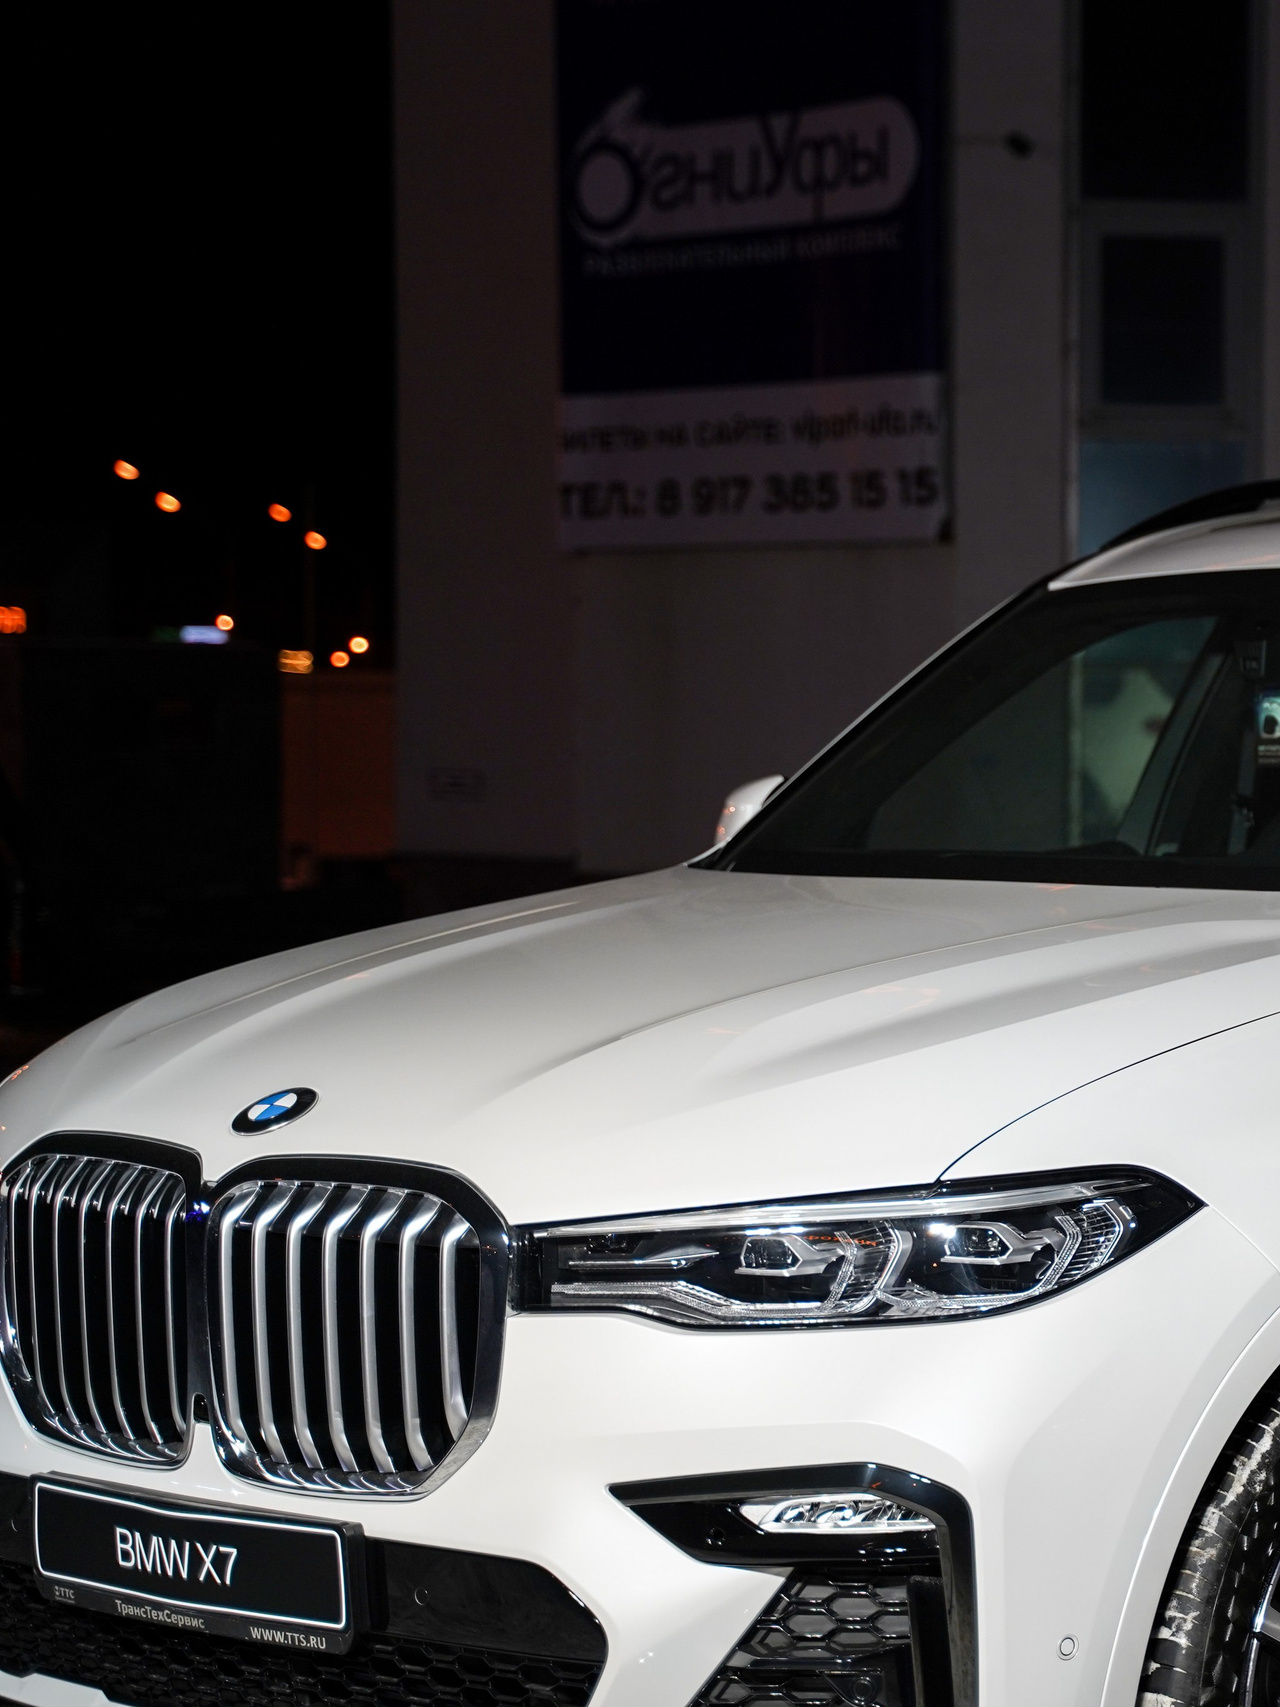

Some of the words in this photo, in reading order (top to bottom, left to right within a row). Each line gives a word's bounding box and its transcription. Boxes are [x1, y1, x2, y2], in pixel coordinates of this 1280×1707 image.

[655, 476, 682, 518] 8
[690, 474, 753, 516] 917
[848, 467, 888, 511] 15
[897, 466, 939, 508] 15
[114, 1526, 191, 1580] BMW
[195, 1541, 238, 1587] X7
[115, 1600, 206, 1629] ТрансТехСервис
[250, 1626, 327, 1650] WWW.TTS.RU
